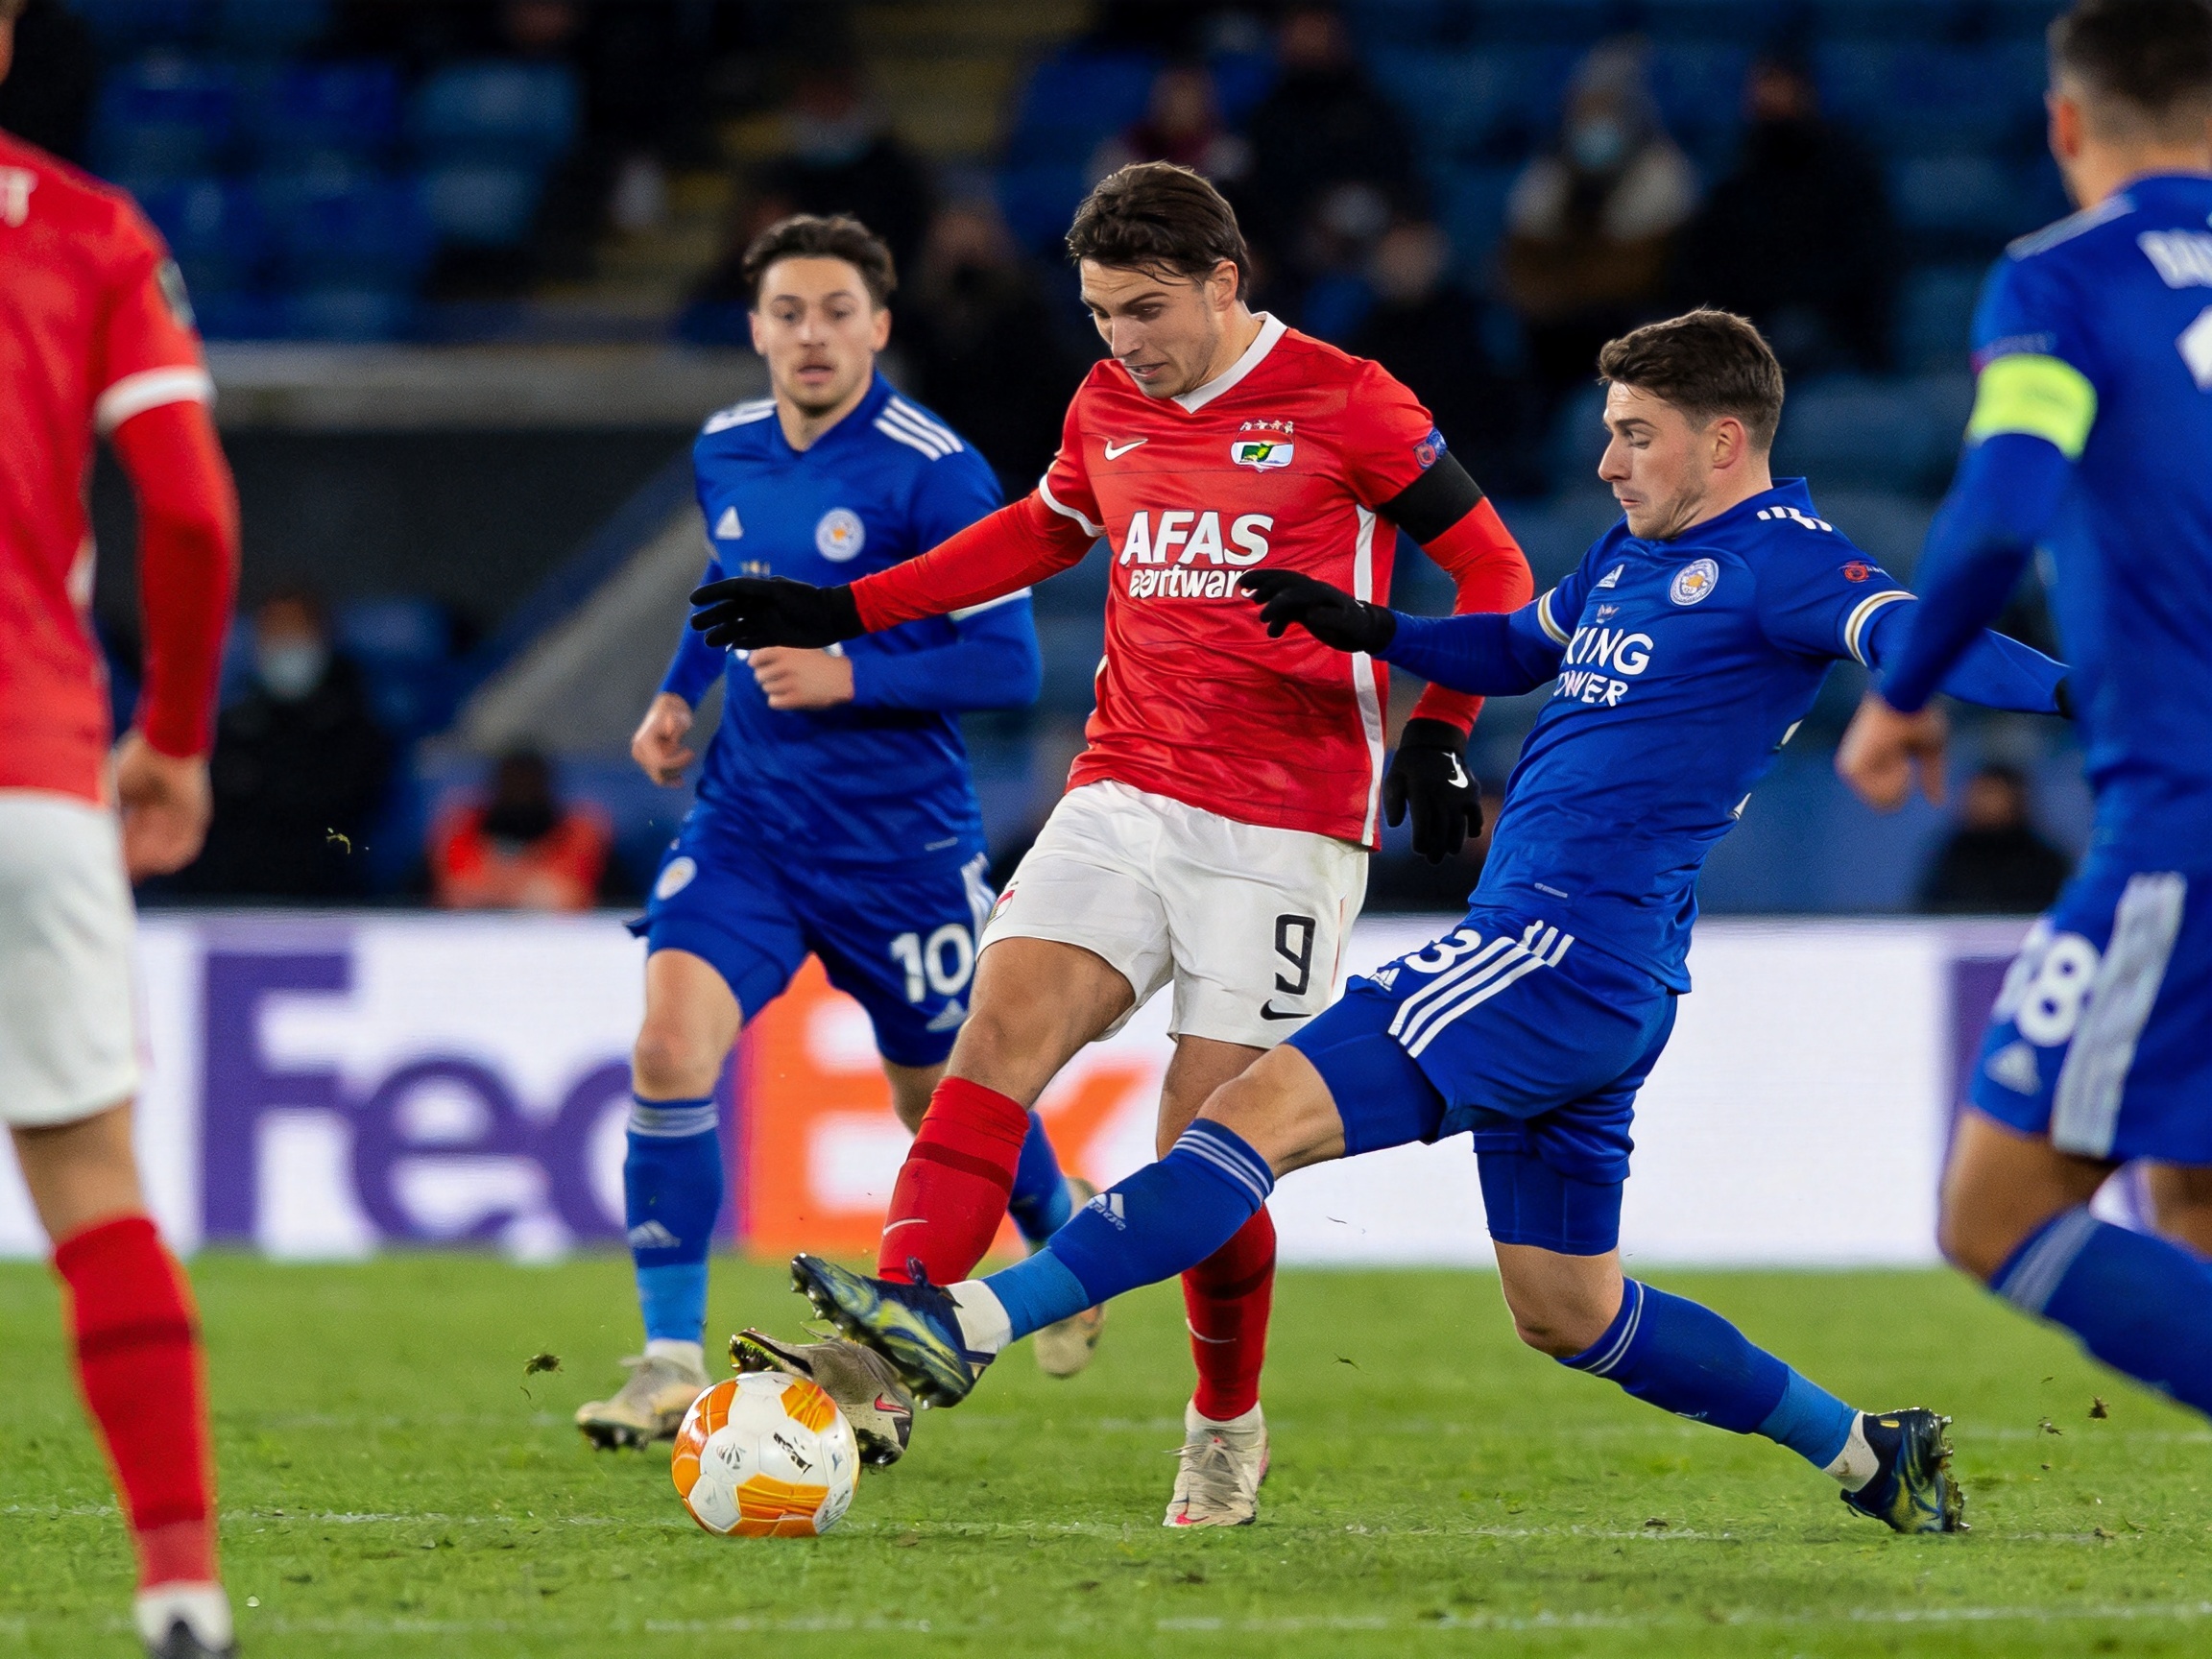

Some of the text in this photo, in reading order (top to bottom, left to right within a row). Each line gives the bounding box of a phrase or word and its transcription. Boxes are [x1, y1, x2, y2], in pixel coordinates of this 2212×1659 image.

[1119, 510, 1274, 565] AFAS
[1553, 669, 1629, 708] OWER
[889, 922, 975, 1004] 10
[1274, 913, 1316, 996] 9
[199, 949, 1150, 1254] FeE
